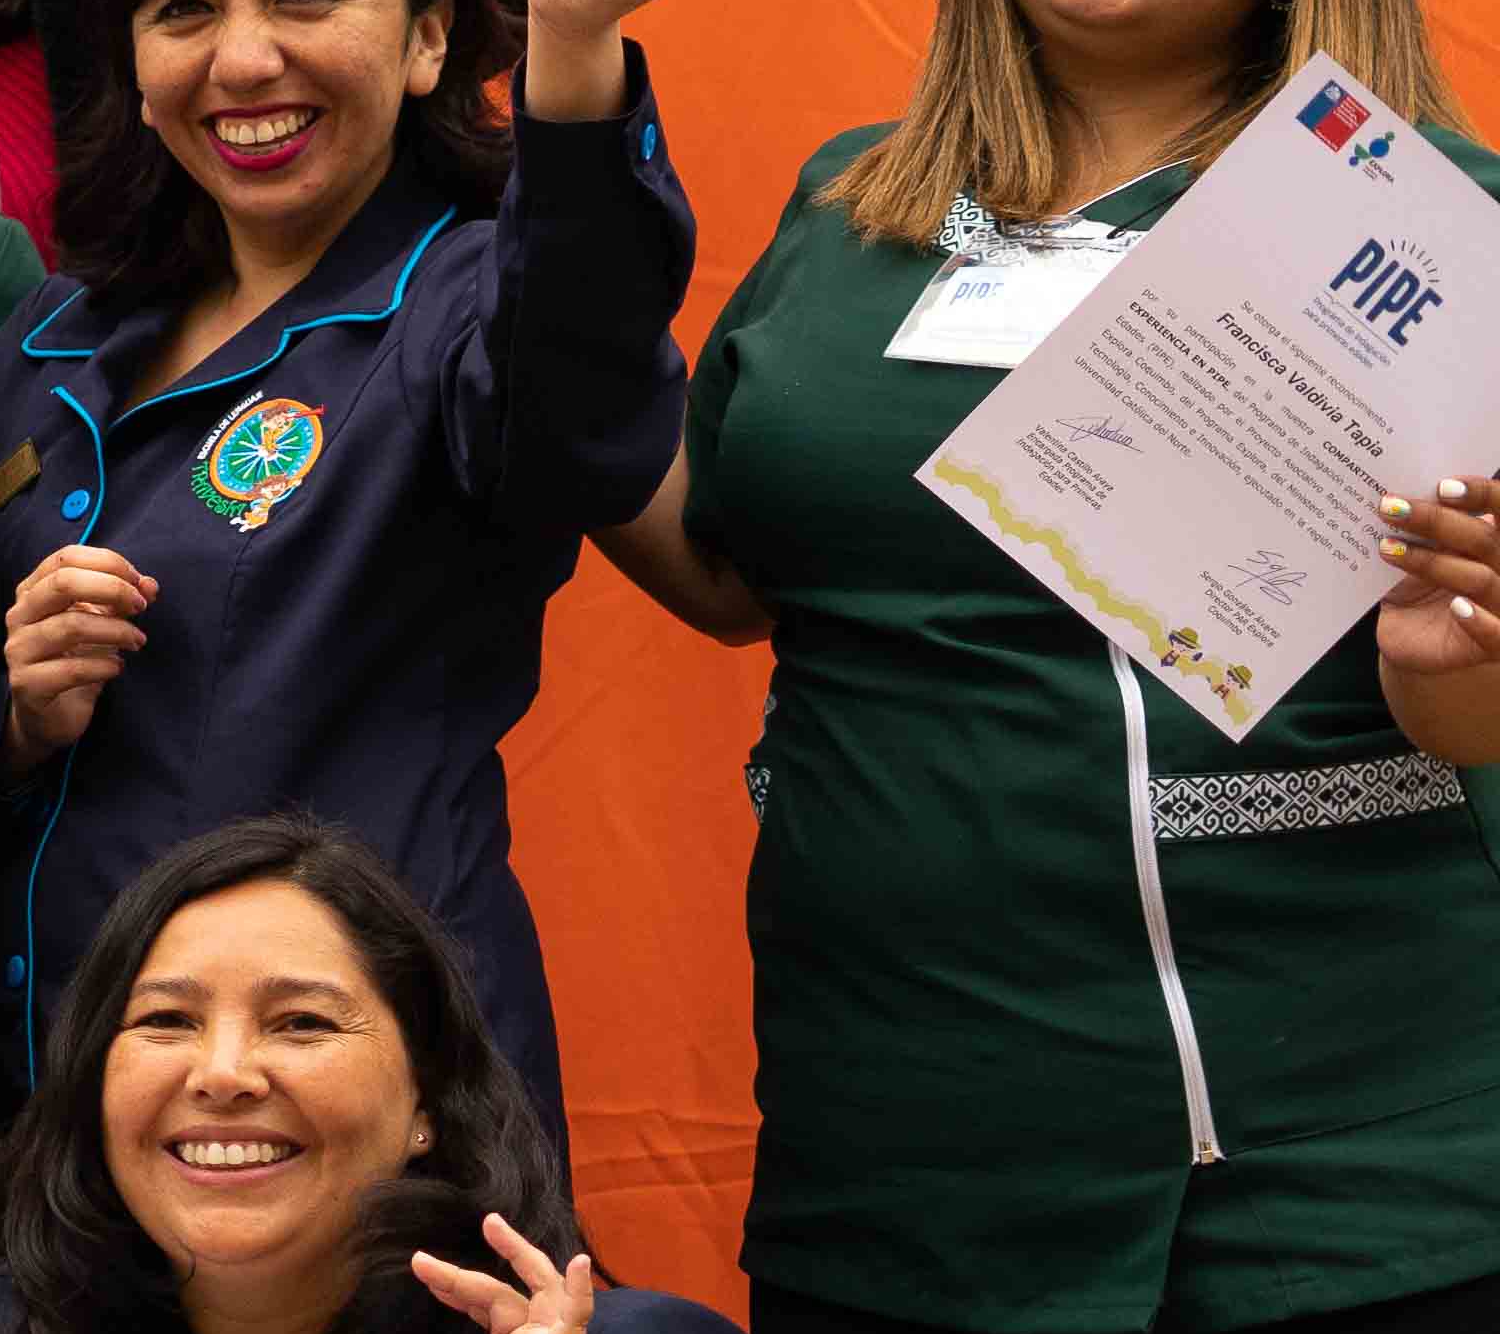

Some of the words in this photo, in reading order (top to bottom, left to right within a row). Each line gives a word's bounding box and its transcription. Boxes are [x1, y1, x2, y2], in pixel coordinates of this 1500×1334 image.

[1129, 301, 1191, 356] EXPERIENCIA
[1190, 354, 1207, 369] EN
[1205, 366, 1230, 391] PIPE,
[1329, 238, 1443, 347] PIPE
[1215, 312, 1287, 375] Francisca
[1287, 370, 1343, 423] Valdivia
[1343, 418, 1383, 458] Tapia
